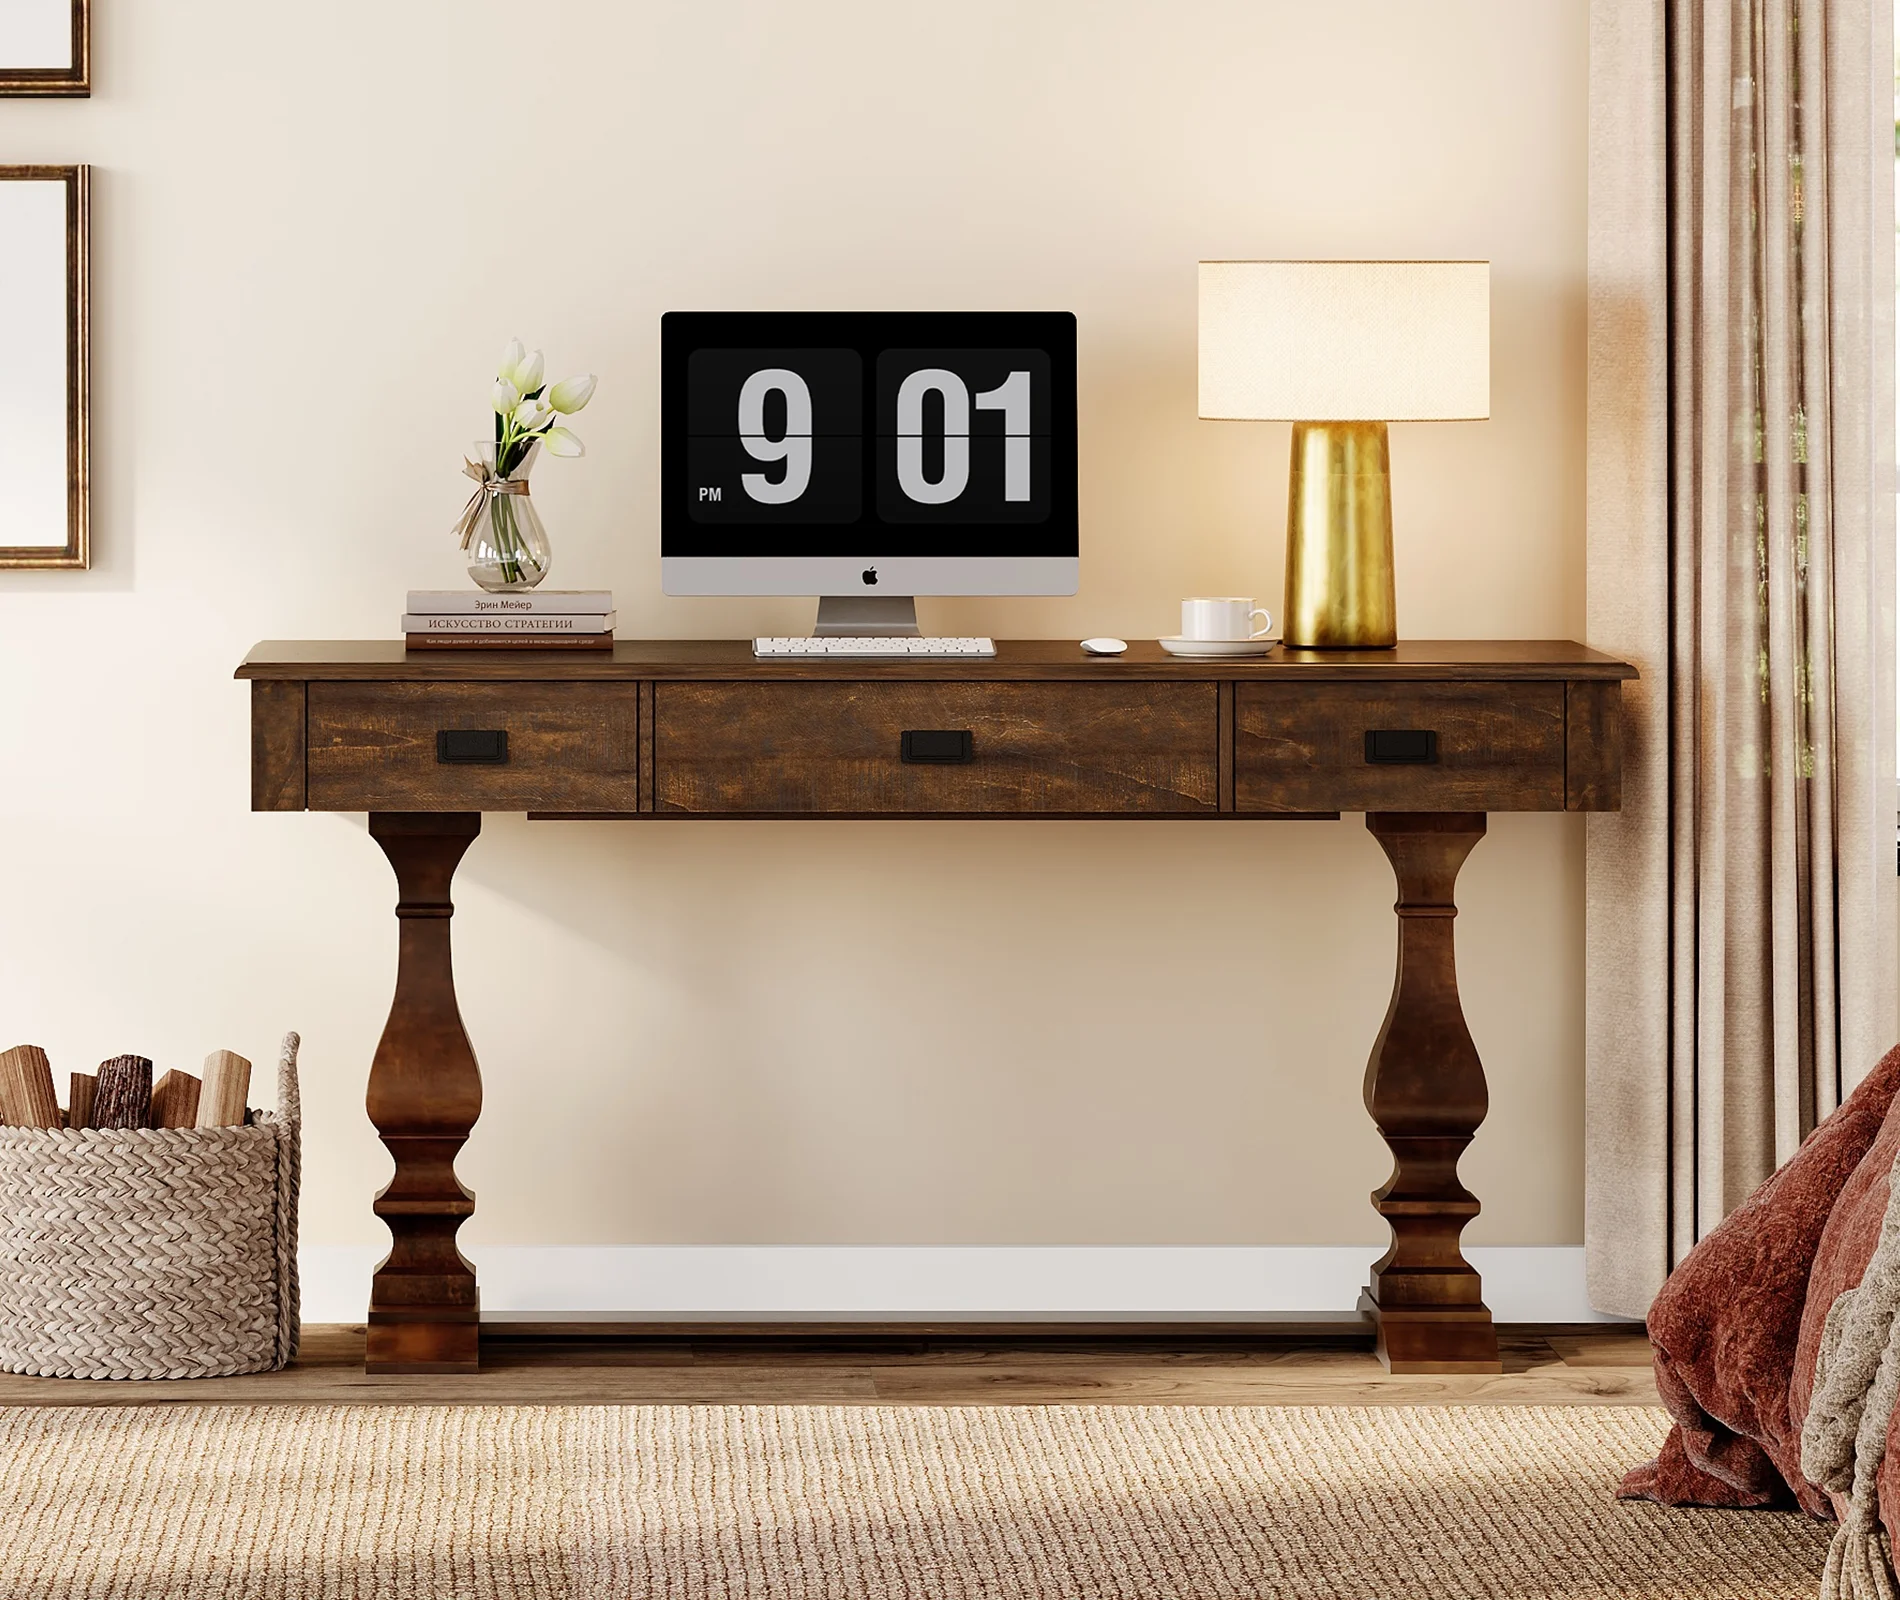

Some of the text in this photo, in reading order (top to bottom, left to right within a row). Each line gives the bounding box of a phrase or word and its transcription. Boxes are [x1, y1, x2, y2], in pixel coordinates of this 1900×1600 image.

[736, 368, 1031, 505] 9 01
[698, 487, 722, 502] PM
[474, 600, 533, 611] Эрин Мейер
[428, 619, 573, 629] ИСКУССТВО СТРАТЕГИИ
